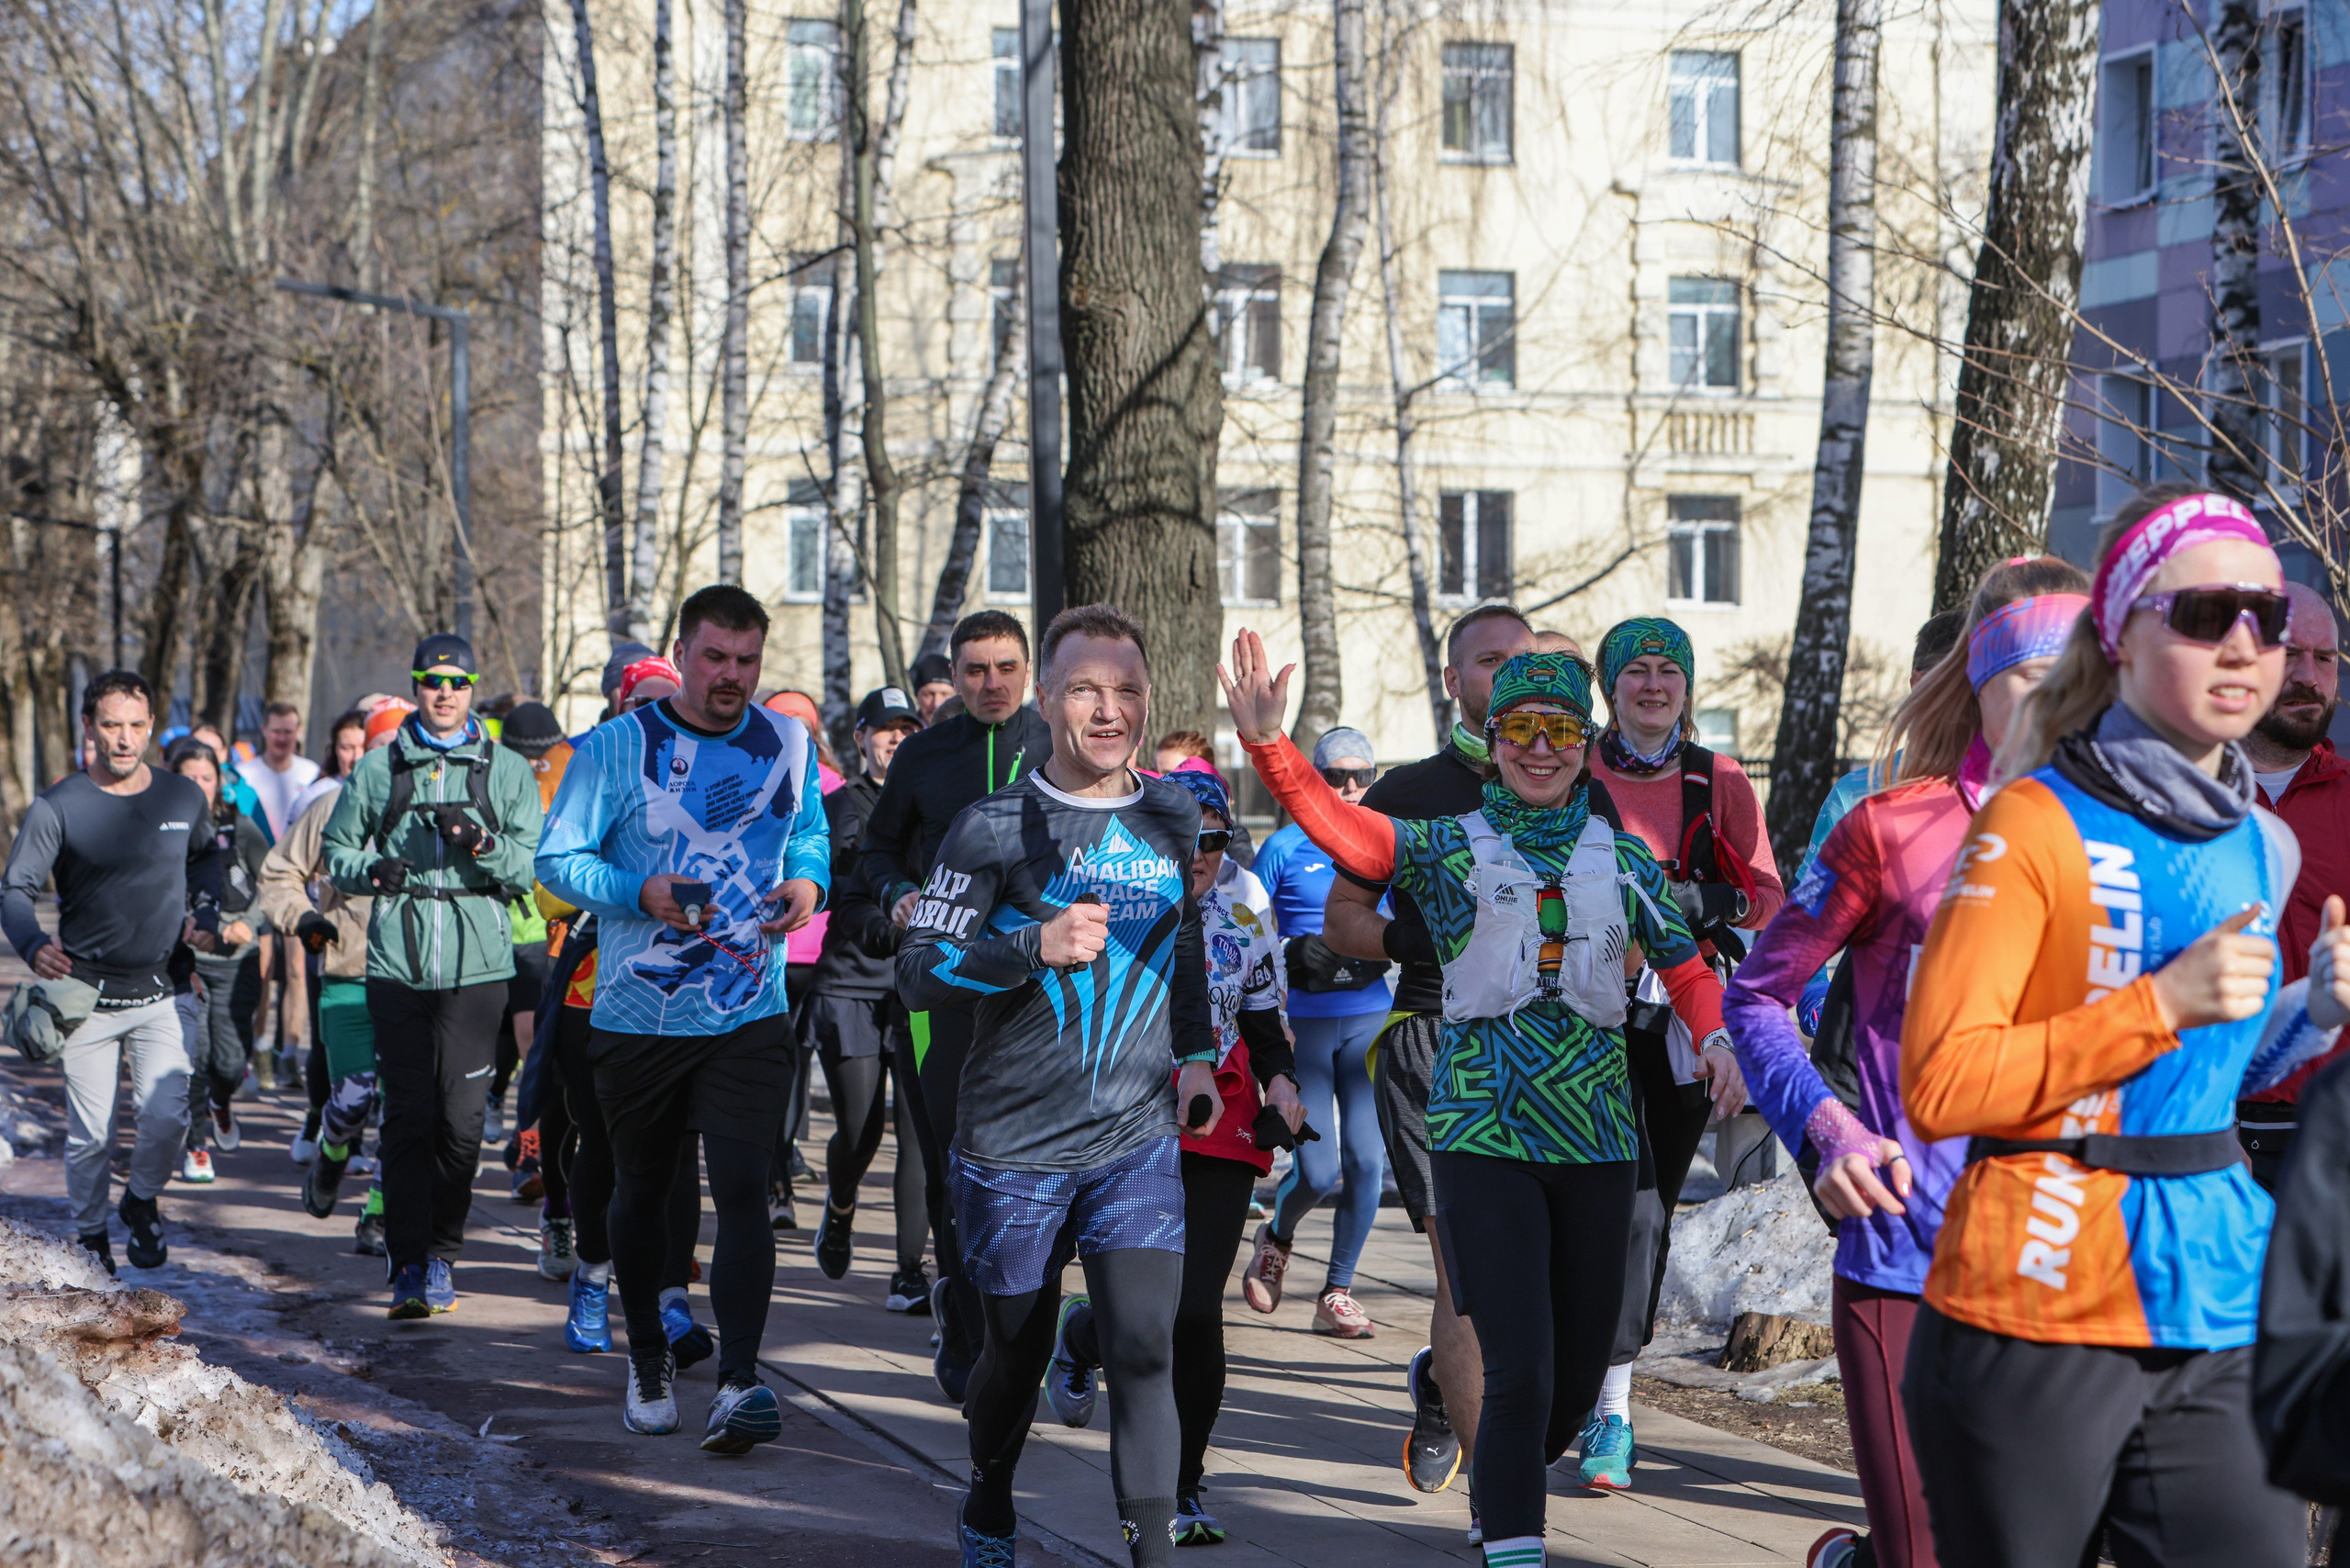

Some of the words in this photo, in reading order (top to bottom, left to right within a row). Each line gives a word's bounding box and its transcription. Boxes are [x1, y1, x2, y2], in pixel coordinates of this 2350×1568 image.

[924, 863, 972, 900] ALP
[1072, 859, 1179, 884] MALIDAK
[1090, 879, 1158, 903] RACE
[1494, 894, 1518, 903] ONIJIE
[907, 900, 979, 939] UBLIC
[1107, 902, 1158, 923] EAM
